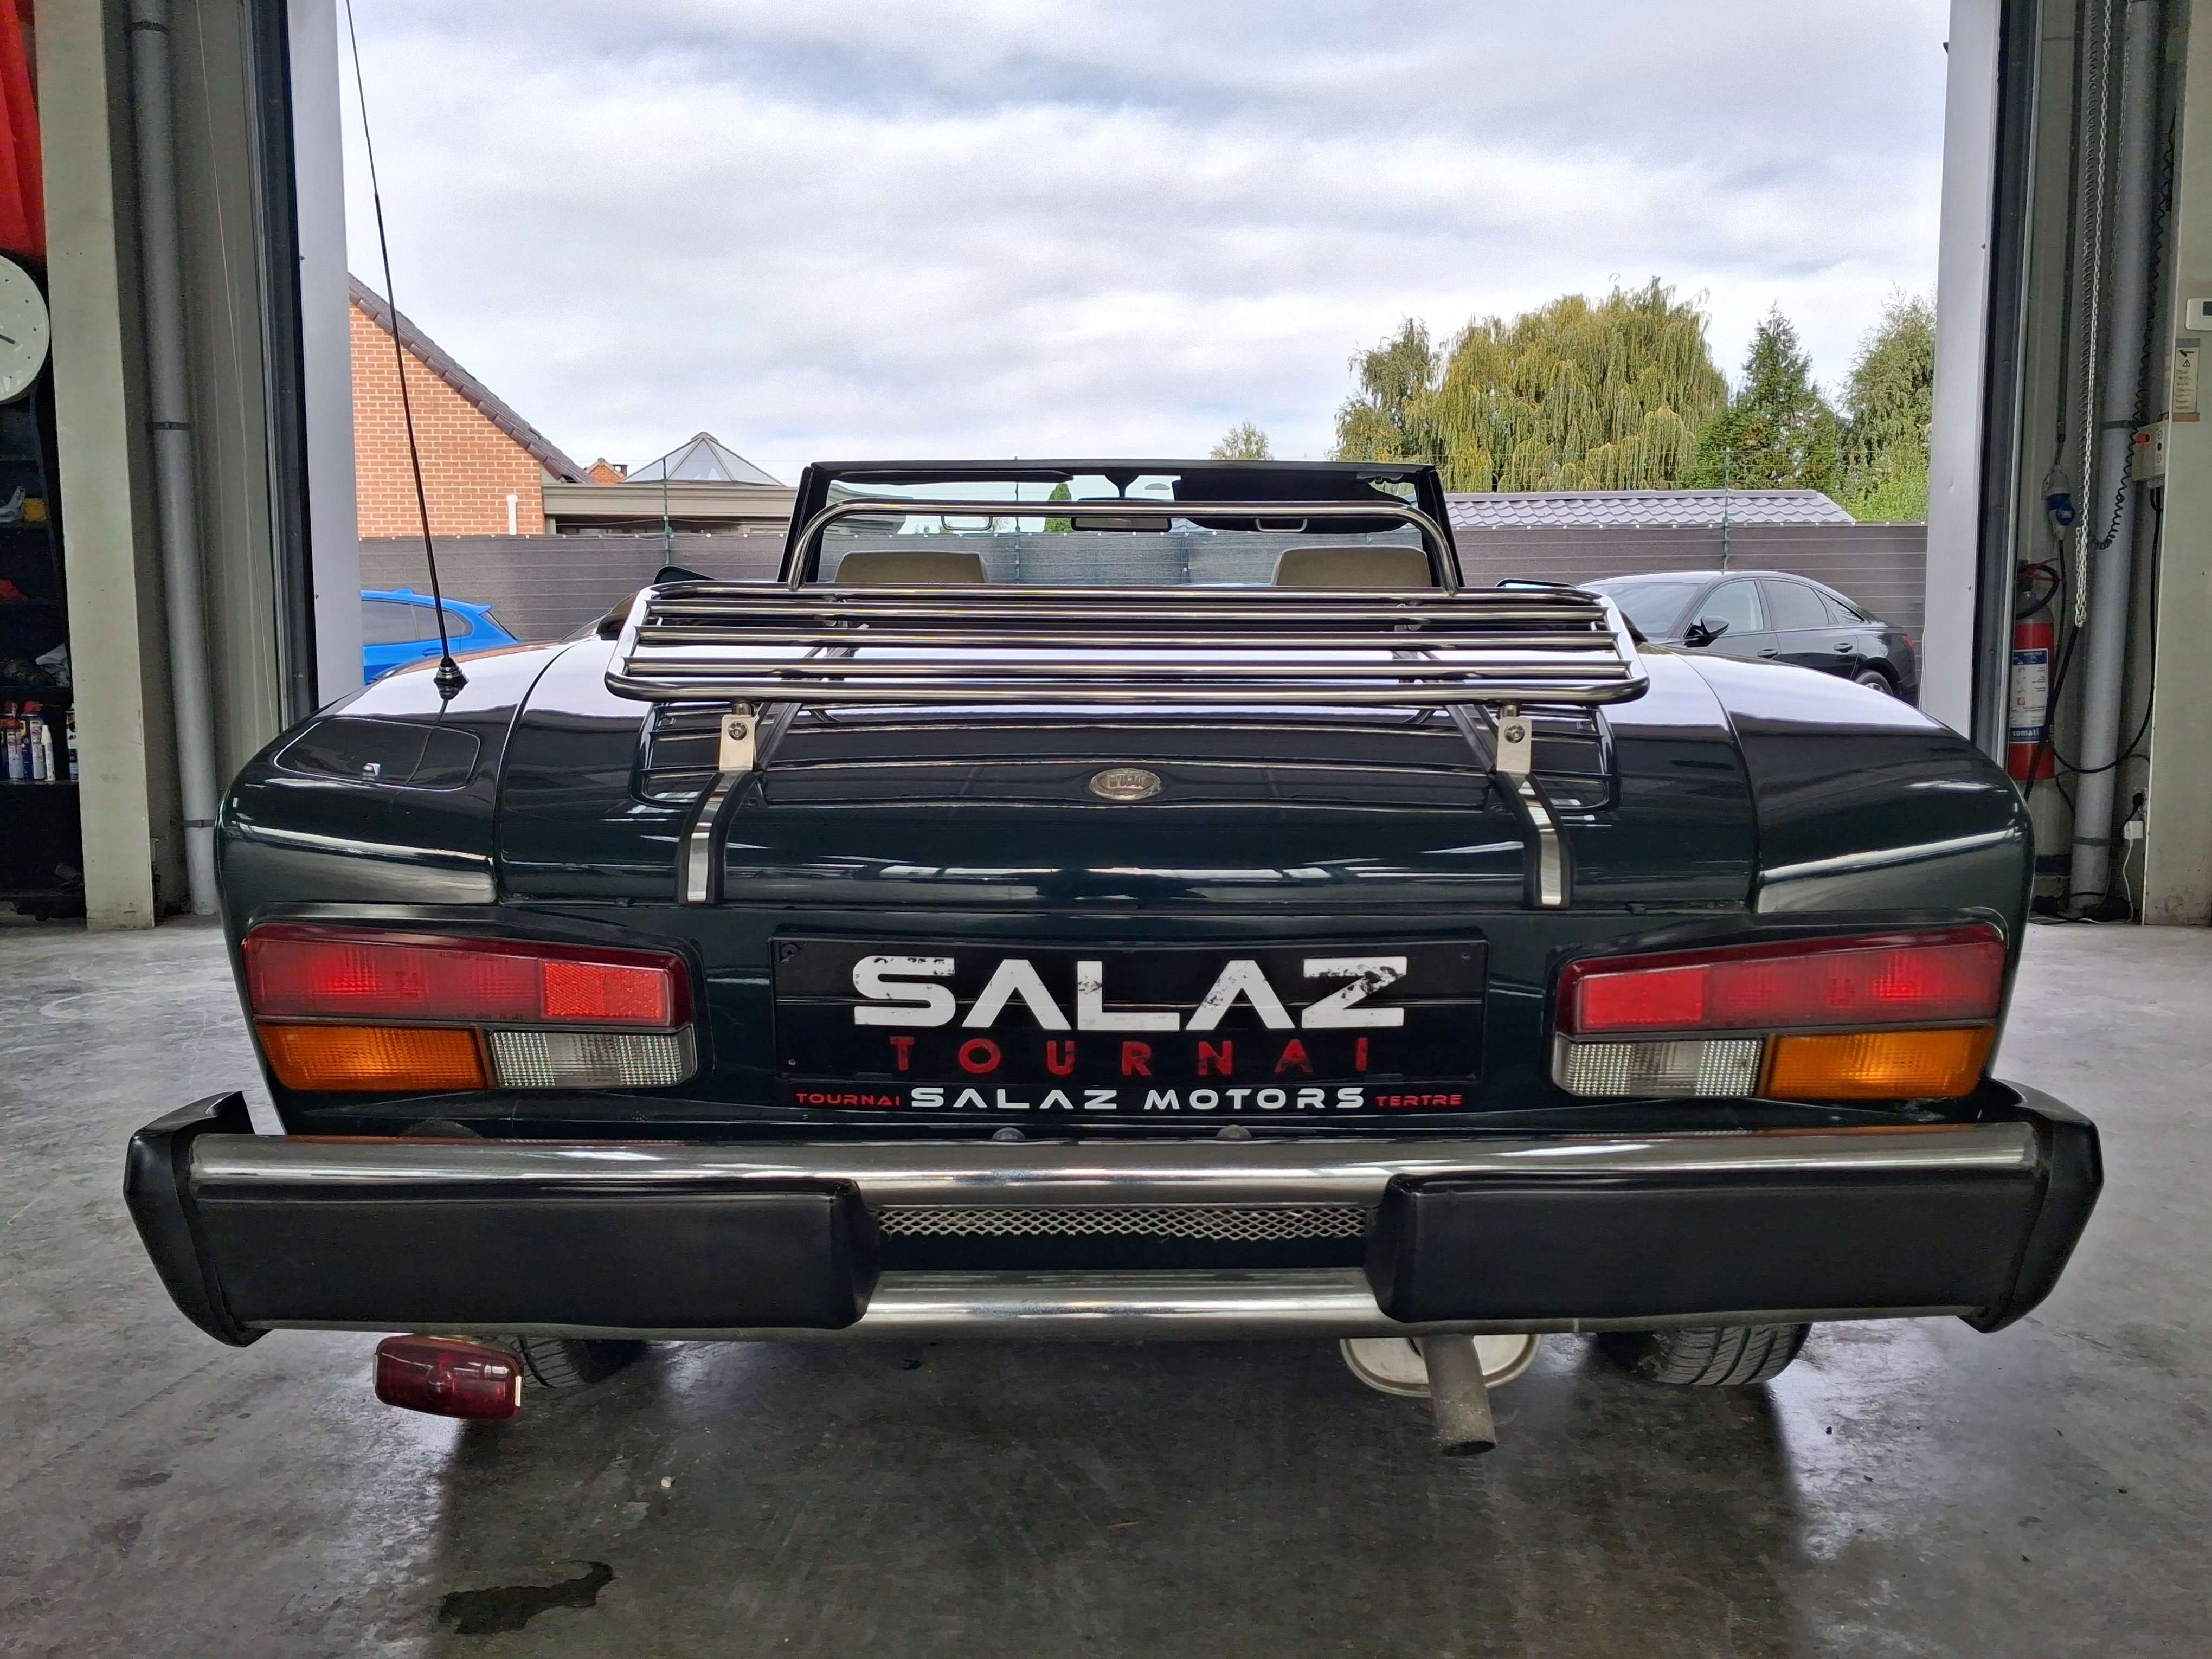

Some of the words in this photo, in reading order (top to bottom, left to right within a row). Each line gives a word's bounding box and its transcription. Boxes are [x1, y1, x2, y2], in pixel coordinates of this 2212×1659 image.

[852, 955, 1407, 1031] SALAZ
[890, 1036, 1368, 1076] TOURNAI
[796, 1092, 901, 1107] TOURNAI
[911, 1087, 1117, 1109] SALAZ
[1143, 1088, 1364, 1110] MOTORS
[1375, 1094, 1462, 1108] TERTRE
